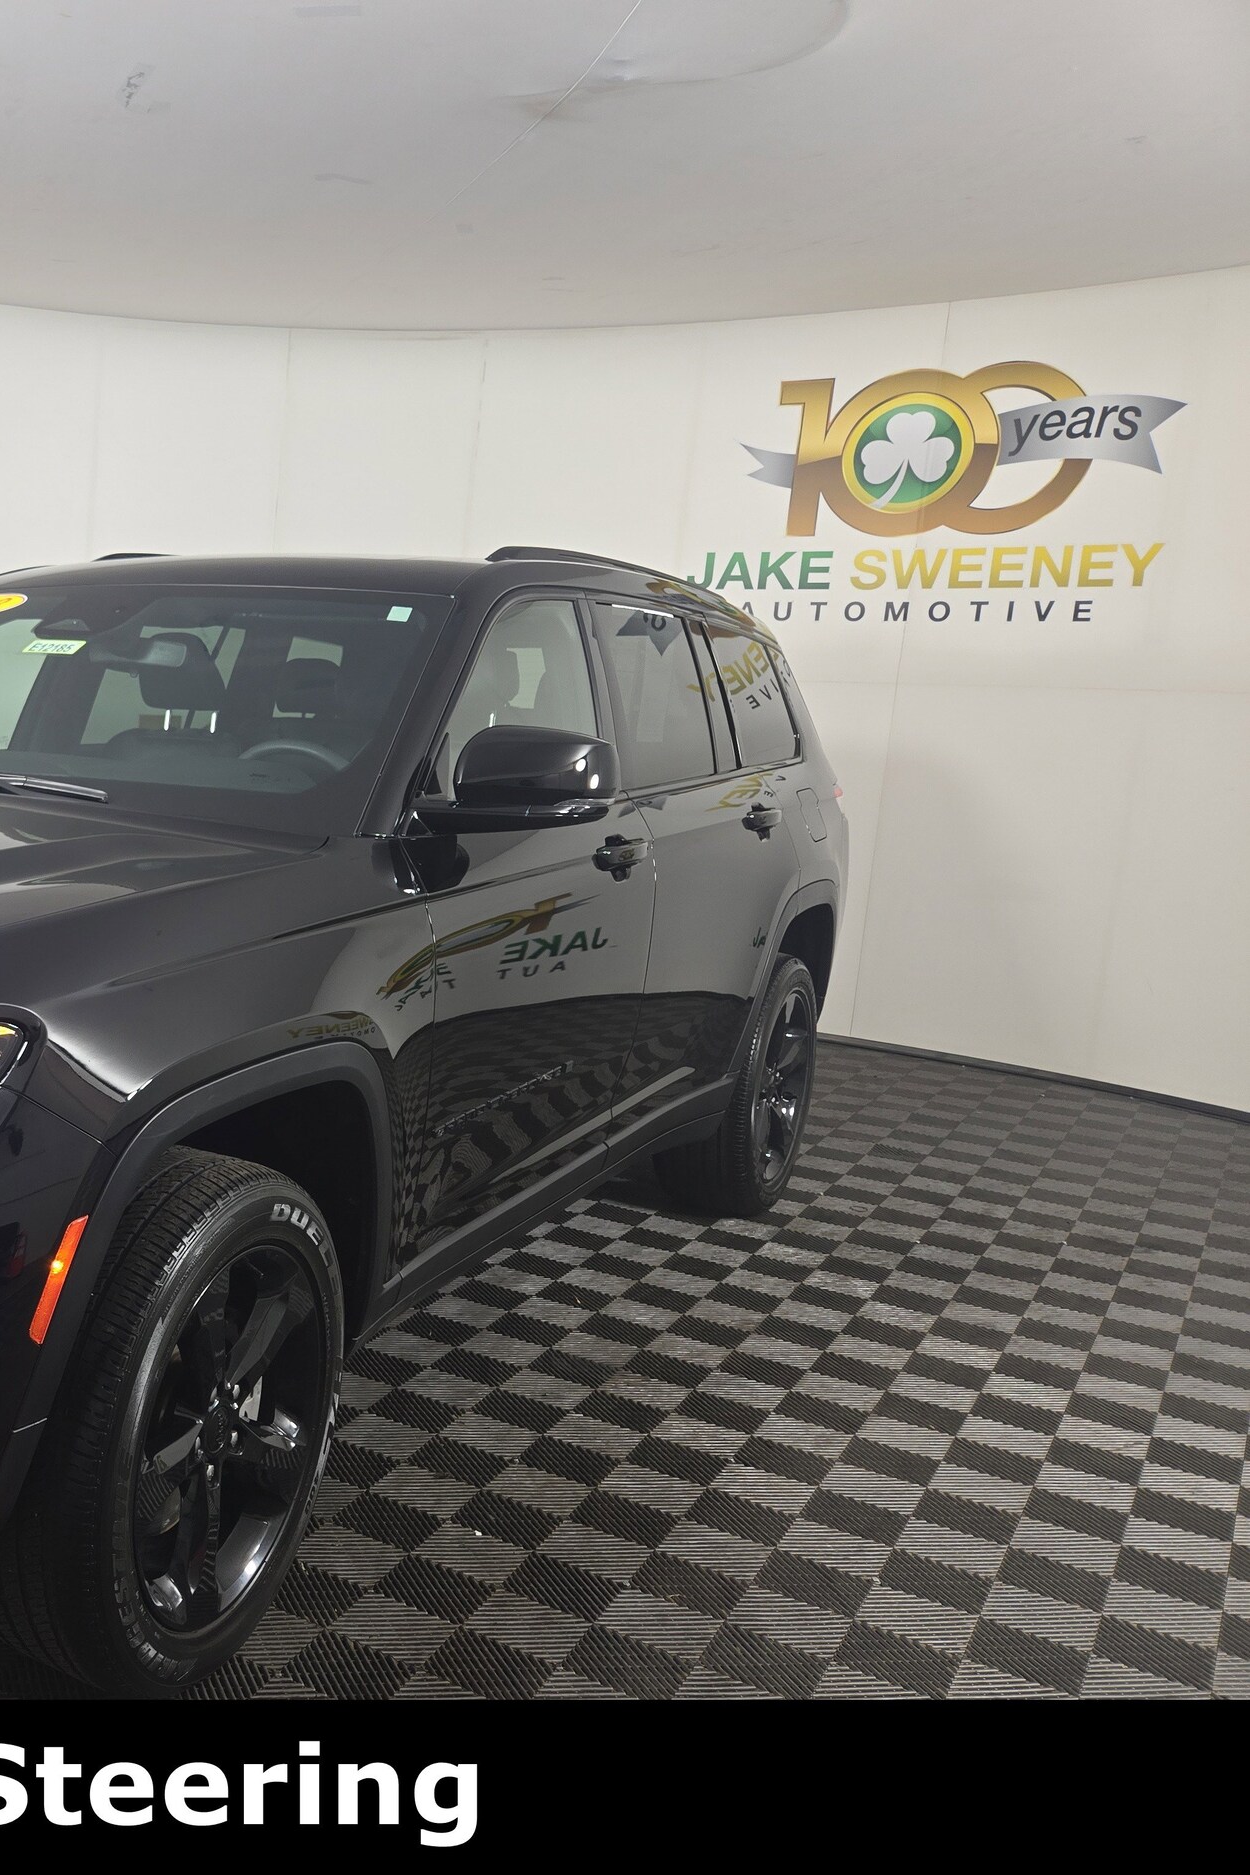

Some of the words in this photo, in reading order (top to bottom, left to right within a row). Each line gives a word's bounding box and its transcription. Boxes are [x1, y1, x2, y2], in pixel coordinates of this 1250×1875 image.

[779, 360, 1093, 537] 100
[1008, 404, 1143, 457] years
[687, 551, 834, 590] JAKE
[850, 542, 1166, 590] SWEENEY
[28, 642, 75, 653] E12185
